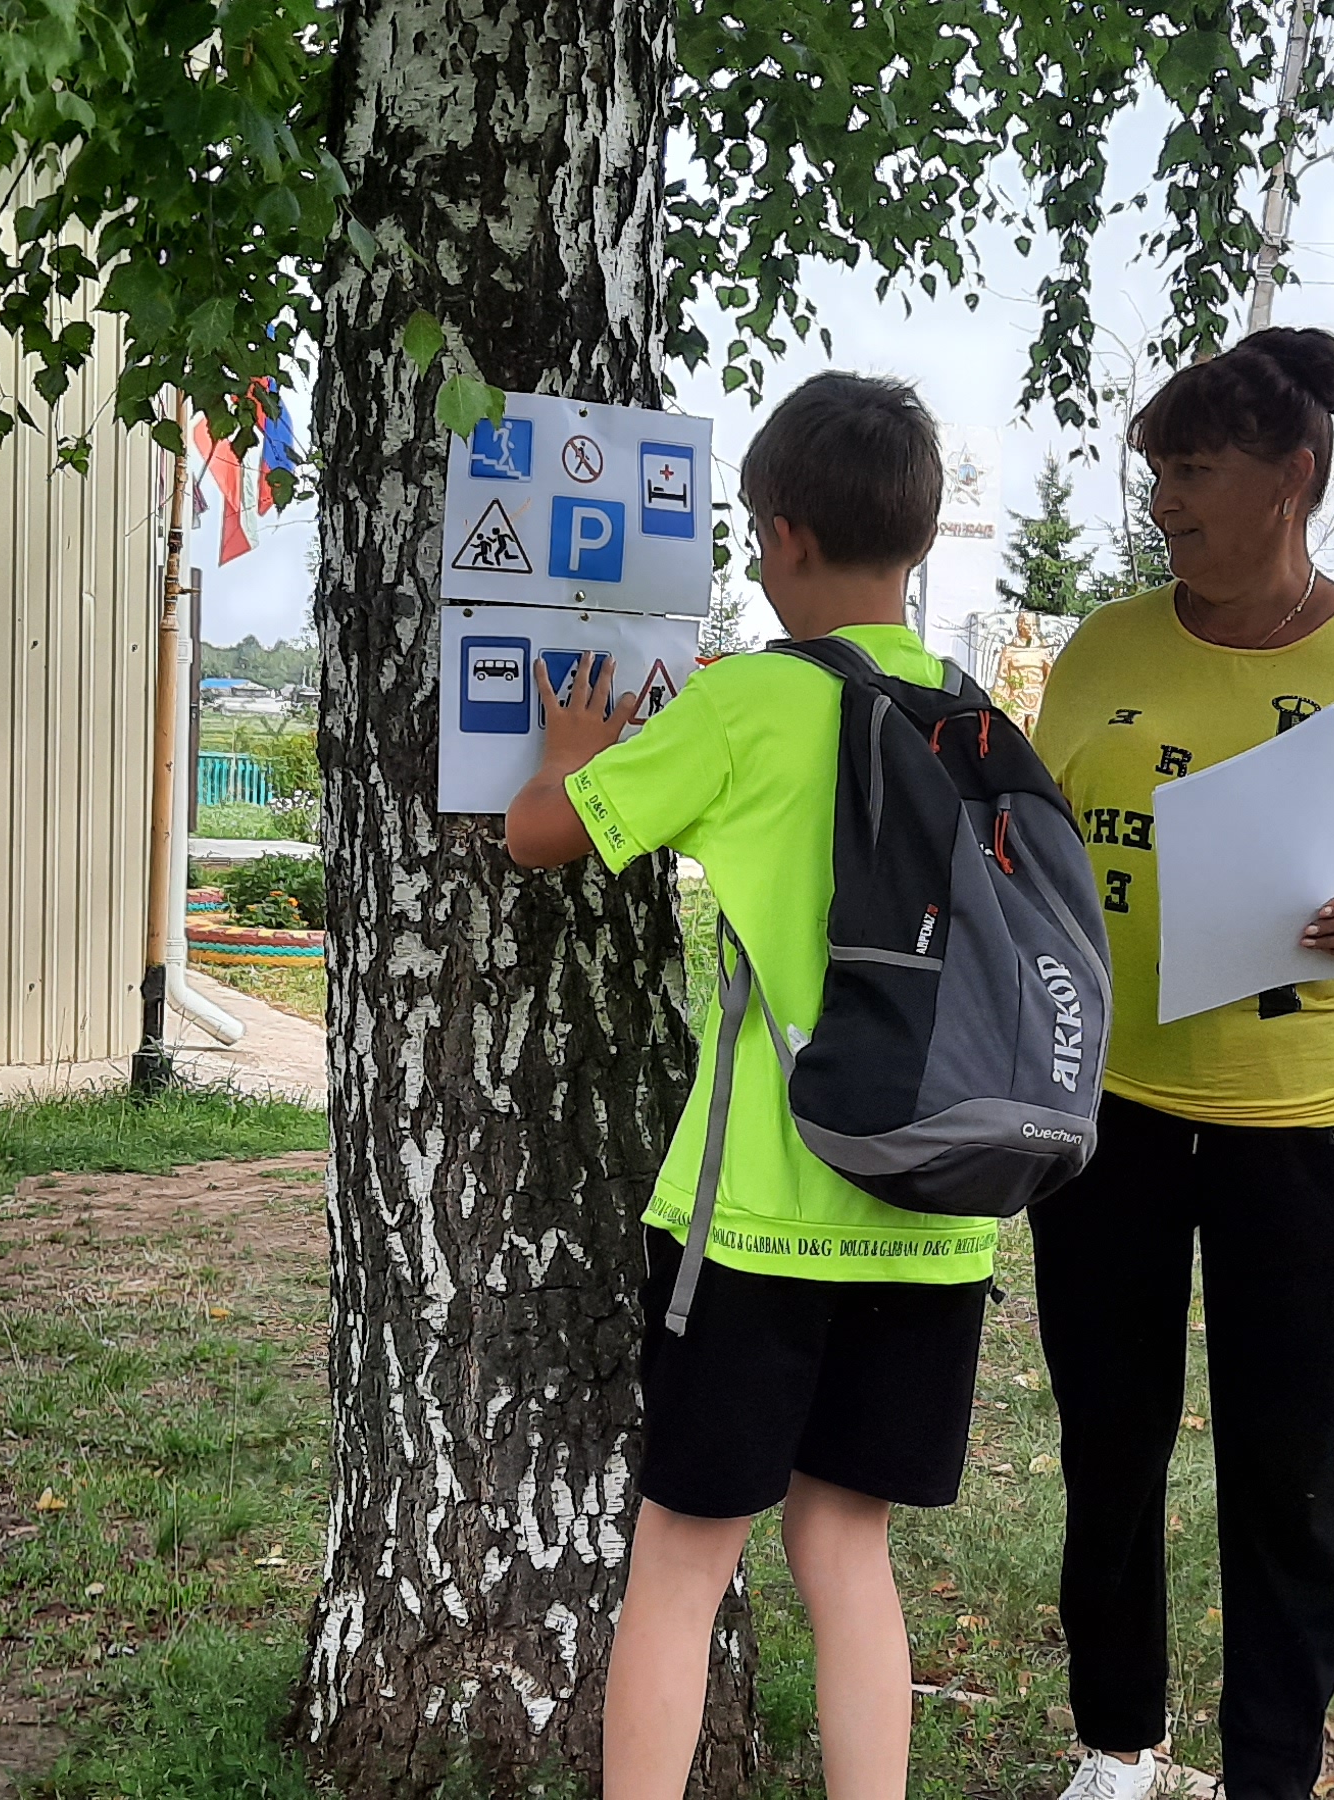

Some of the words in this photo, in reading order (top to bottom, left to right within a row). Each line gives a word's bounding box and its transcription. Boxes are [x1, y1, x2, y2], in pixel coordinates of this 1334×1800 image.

[569, 506, 613, 571] P
[1155, 744, 1193, 777] R
[588, 794, 609, 820] D&G
[607, 823, 627, 850] D&G
[746, 1234, 792, 1255] GABBANA
[798, 1238, 833, 1257] D&G
[922, 1239, 952, 1256] D&G
